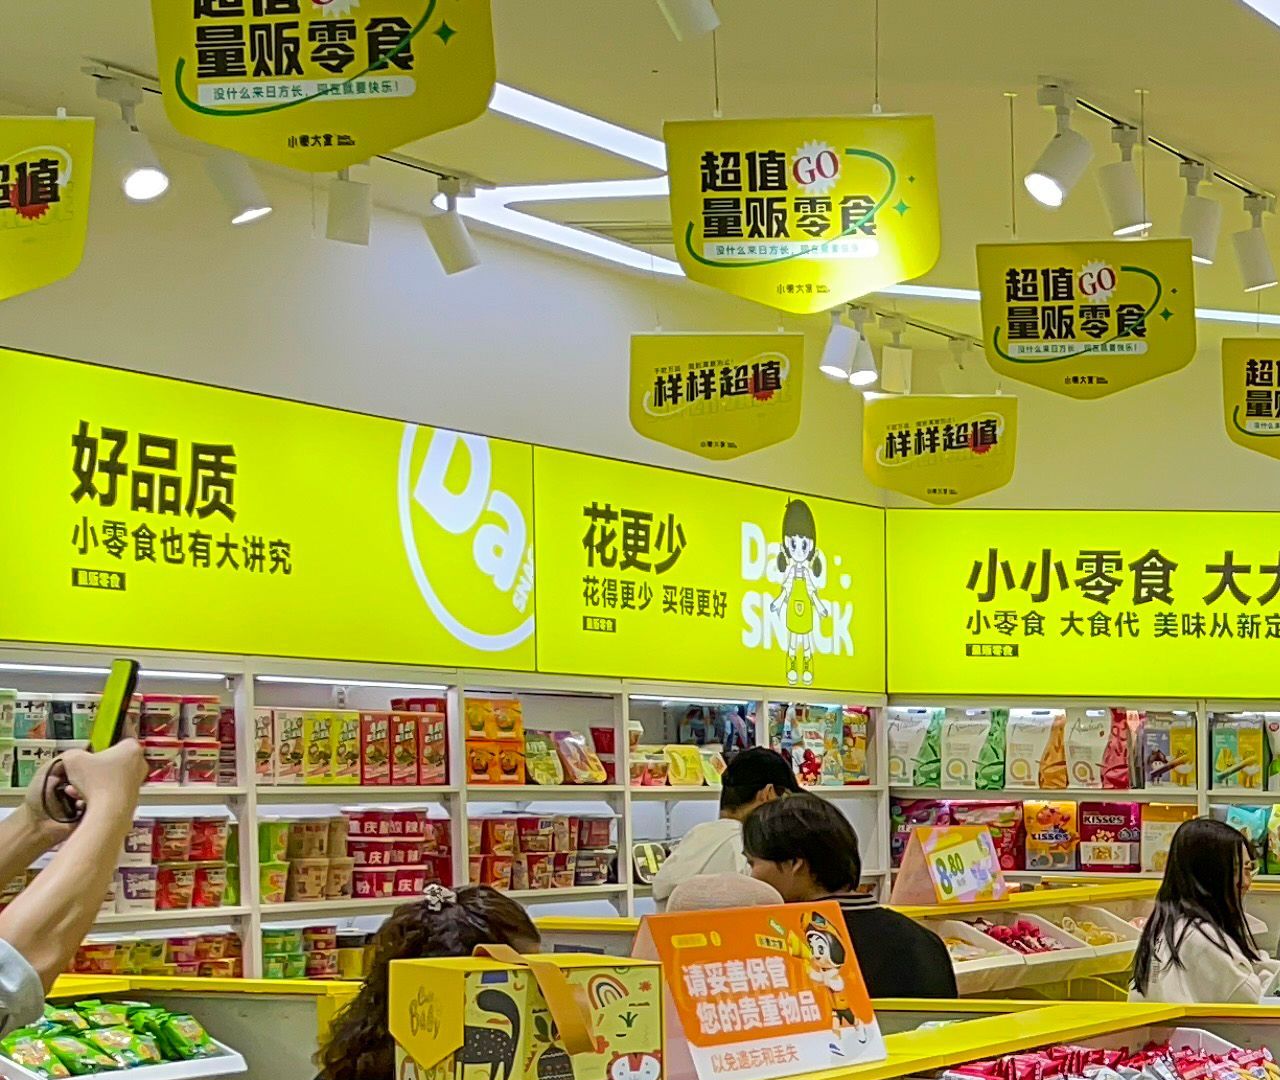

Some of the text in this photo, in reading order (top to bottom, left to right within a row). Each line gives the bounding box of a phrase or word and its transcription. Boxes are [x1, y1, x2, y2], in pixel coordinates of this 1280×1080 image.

[195, 17, 414, 78] 量贩零食
[700, 150, 840, 193] 超值 GO
[701, 196, 877, 239] 量贩零食
[1005, 267, 1116, 302] 超值 GO
[1007, 304, 1147, 340] 量贩零食
[654, 360, 782, 407] 样样超值
[885, 419, 999, 459] 样样超值
[71, 419, 238, 522] 好品质
[71, 516, 293, 576] 小零食也有大讲究
[582, 503, 688, 575] 花更少
[582, 576, 728, 620] 花得更少 买得更好
[966, 547, 1179, 606] 小小零食
[741, 591, 855, 657] SNCK
[966, 609, 1046, 638] 小零食
[1060, 610, 1139, 639] 大食代
[681, 955, 790, 997] 请妥善保管
[696, 990, 822, 1035] 您的贵重物品
[711, 1045, 800, 1073] 以免遗忘和丢失
